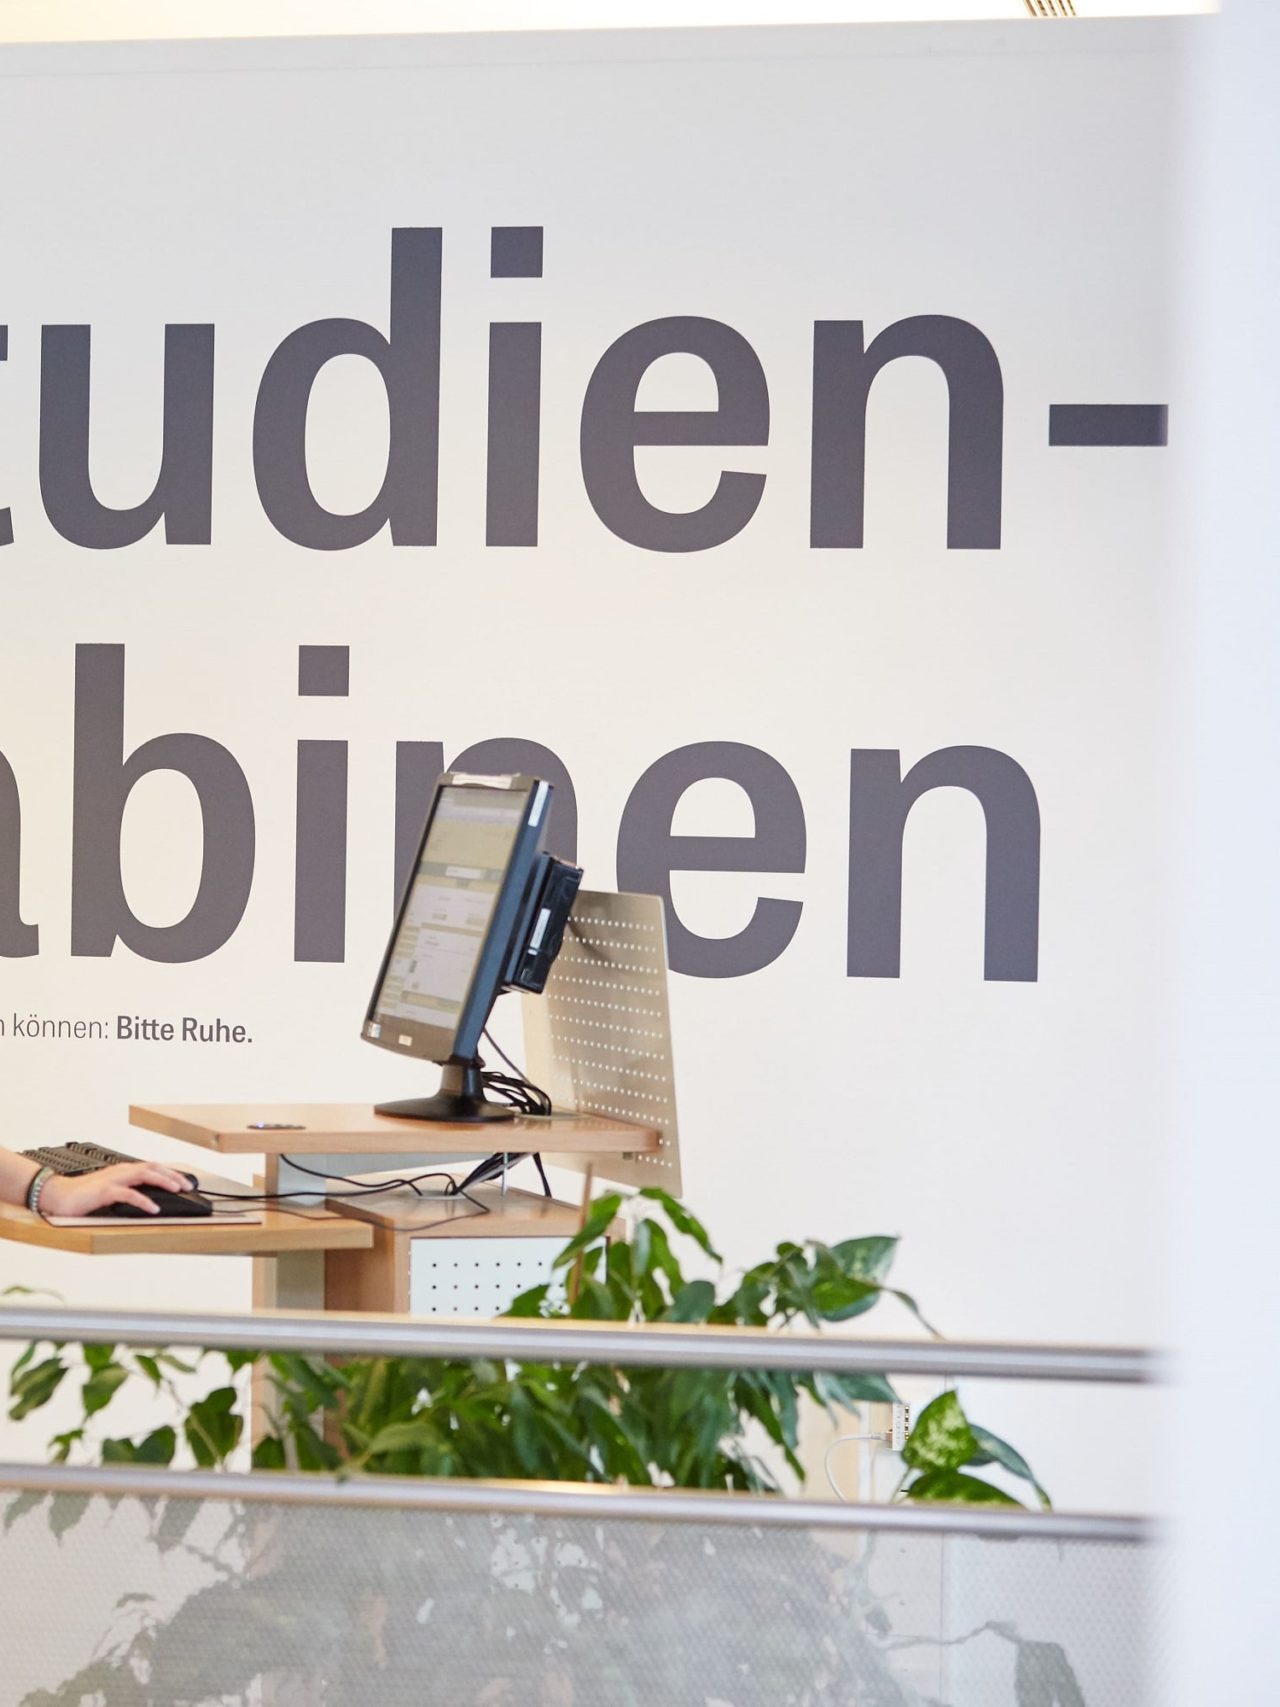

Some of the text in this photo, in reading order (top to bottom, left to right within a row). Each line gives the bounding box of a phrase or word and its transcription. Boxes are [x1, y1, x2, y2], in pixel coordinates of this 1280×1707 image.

[13, 1012, 109, 1039] können:
[116, 1015, 175, 1041] Bitte
[182, 1017, 254, 1043] Ruhe.
